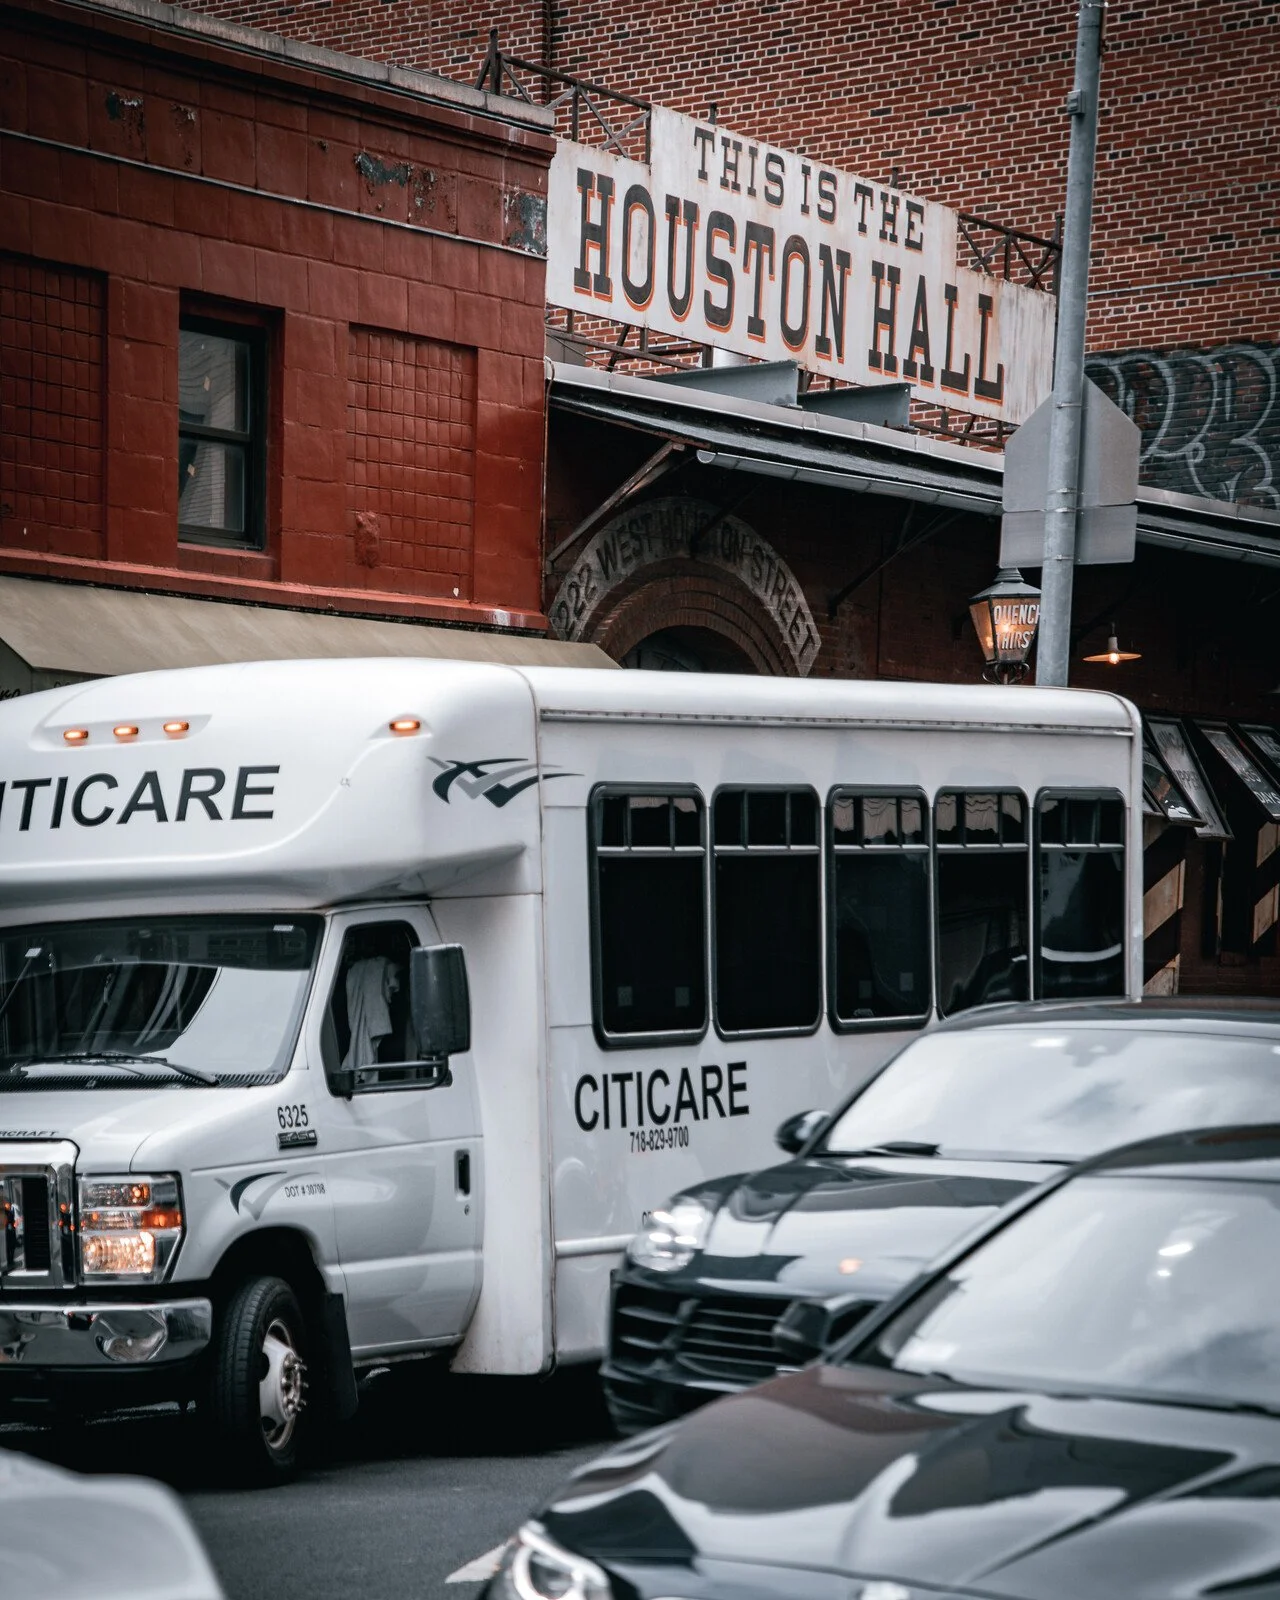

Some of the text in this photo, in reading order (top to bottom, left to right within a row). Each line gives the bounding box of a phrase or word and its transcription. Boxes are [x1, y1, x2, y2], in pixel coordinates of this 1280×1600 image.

[694, 126, 926, 253] THIS IS THE
[573, 167, 1005, 407] HOUSTON HALL
[596, 513, 655, 580] WEST
[751, 545, 816, 656] STREET
[996, 630, 1035, 650] THIRS
[277, 1104, 309, 1129] 6325
[574, 1061, 750, 1132] CITICARE
[629, 1125, 690, 1153] 718-829-9700
[284, 1185, 300, 1198] DOT
